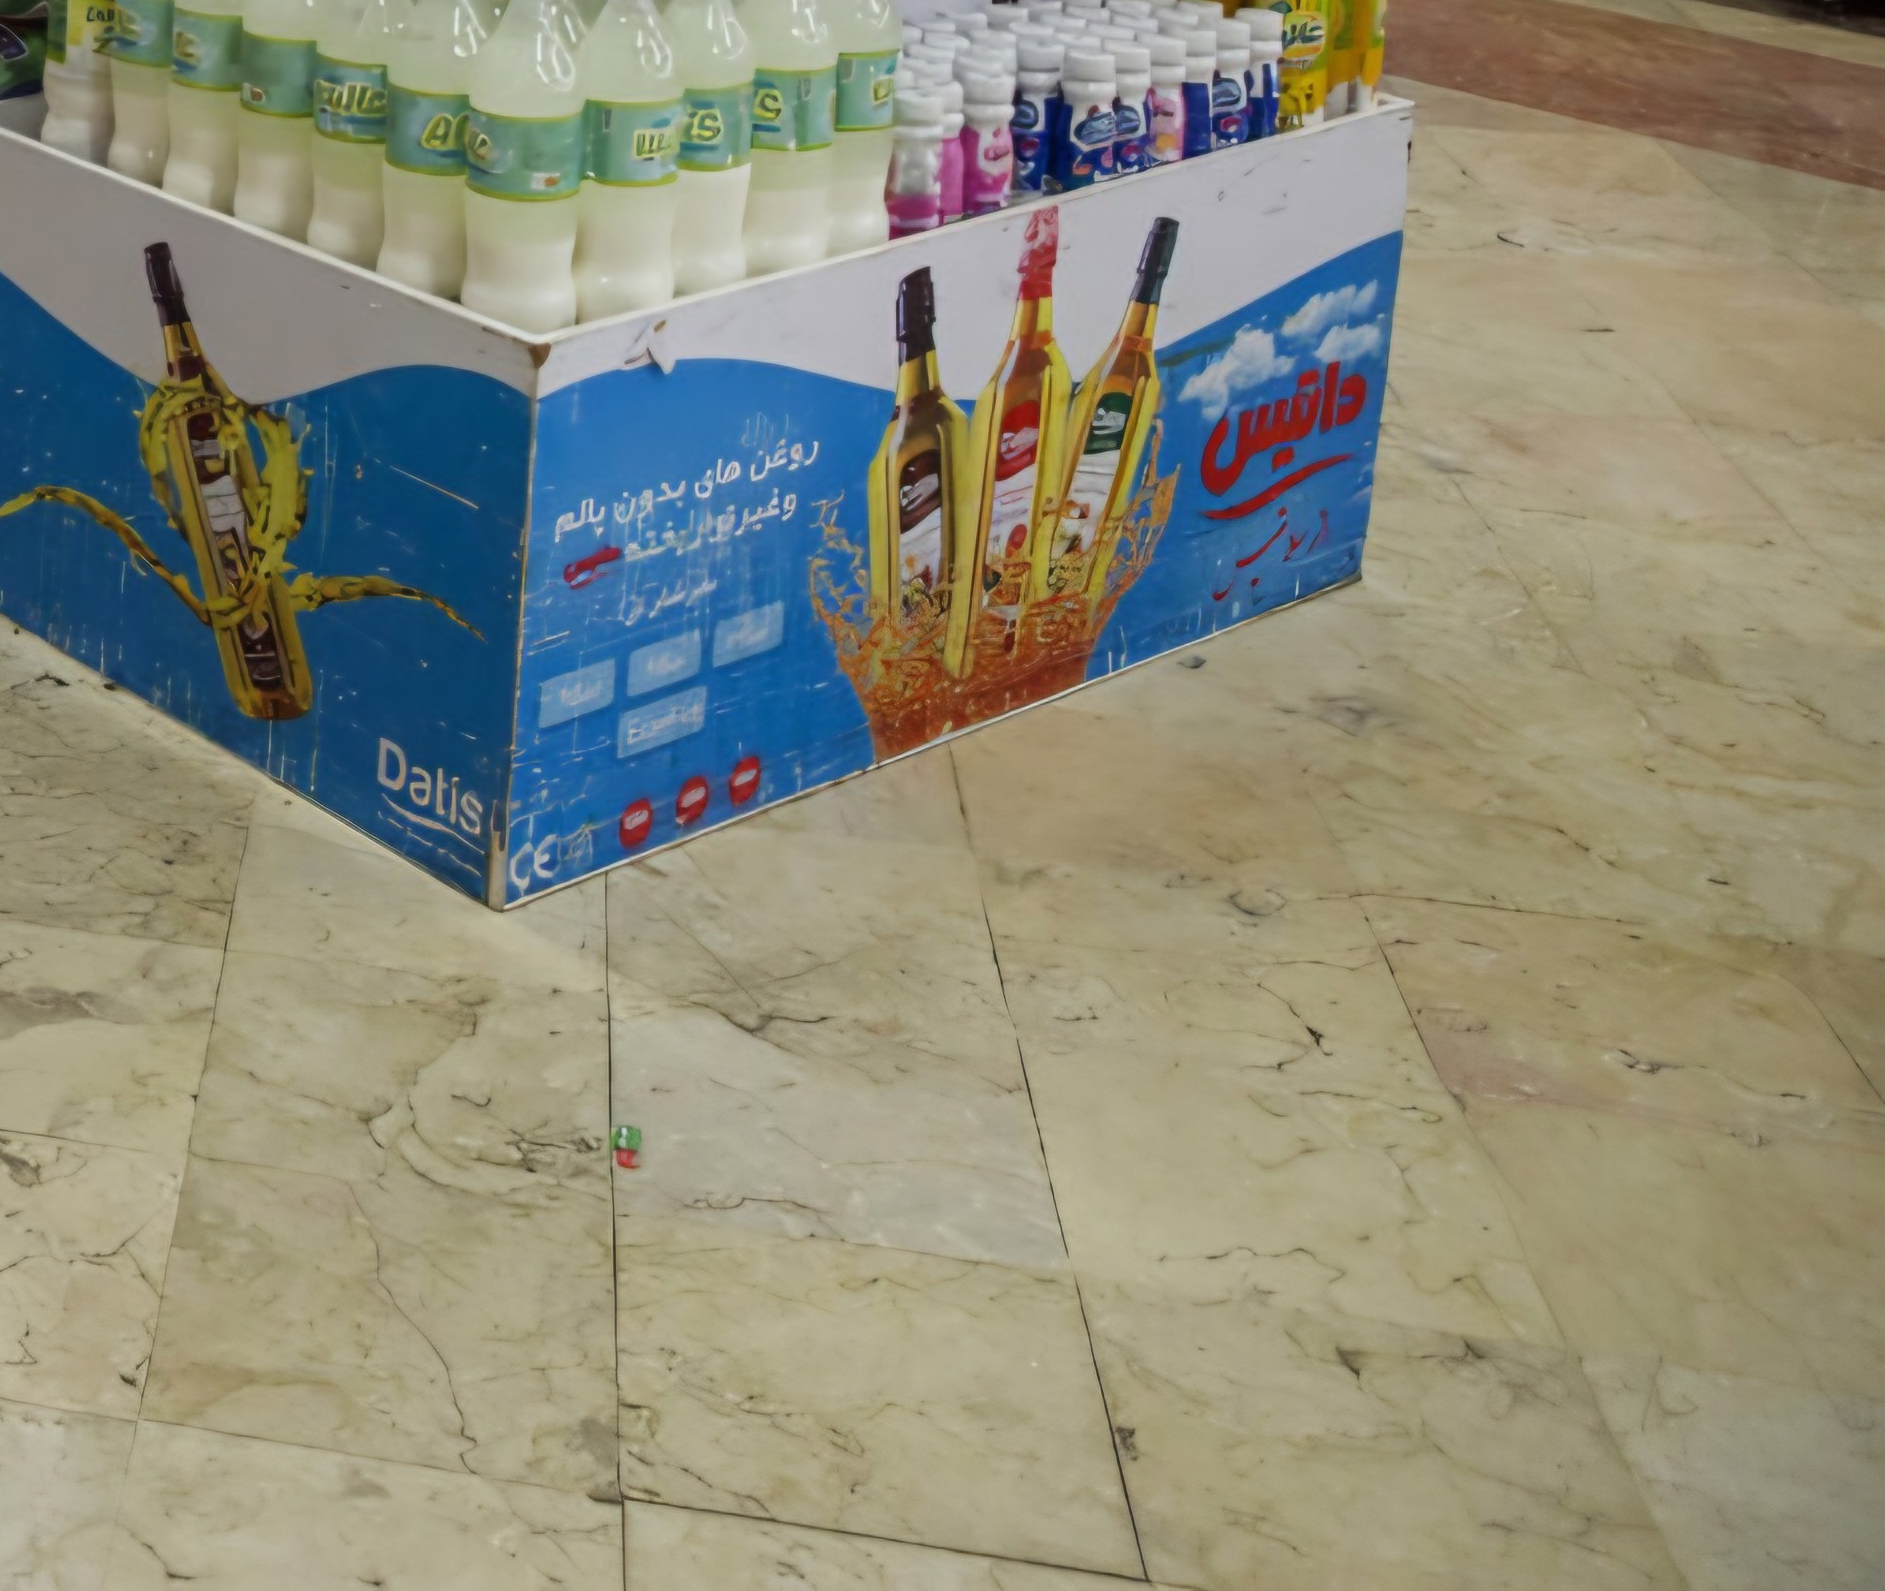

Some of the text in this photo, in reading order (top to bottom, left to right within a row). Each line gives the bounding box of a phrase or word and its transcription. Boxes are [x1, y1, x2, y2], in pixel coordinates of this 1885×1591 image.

[749, 438, 820, 483] روغن
[1199, 360, 1368, 499] داتیس
[613, 479, 687, 526] بدون
[376, 736, 484, 837] Datis
